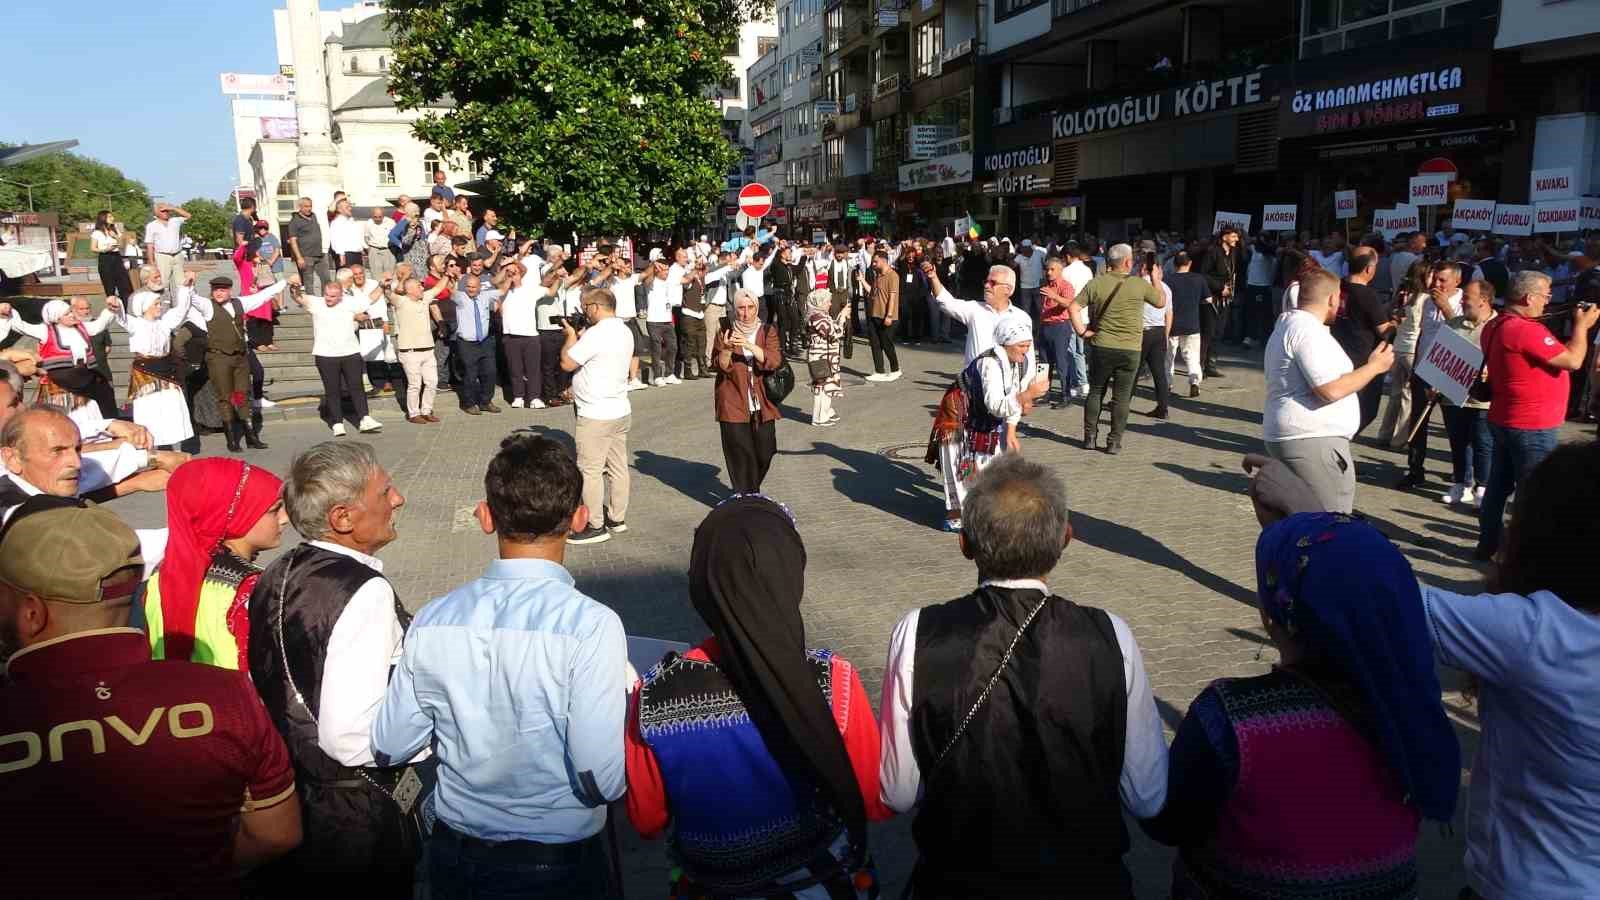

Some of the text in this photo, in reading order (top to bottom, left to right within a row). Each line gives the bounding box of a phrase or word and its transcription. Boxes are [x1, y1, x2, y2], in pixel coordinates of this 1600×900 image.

[1292, 66, 1463, 113] ÖZ KARAMEHMETLER
[1052, 73, 1262, 139] KOLOTOĞLU KÖFTE
[985, 146, 1050, 171] KOLOTOĞLU
[997, 174, 1033, 193] KÖFTE
[1412, 184, 1445, 198] SARITAŞ
[1536, 176, 1569, 192] KAVAKLI
[1265, 211, 1295, 222] AKÖREN
[1454, 207, 1493, 221] AKÇAKÖY
[1497, 209, 1531, 226] UĞURLU
[1537, 208, 1577, 223] ÖZAKDAMAR
[1386, 216, 1417, 230] AKDAMAR
[1426, 341, 1479, 389] KARAMAN
